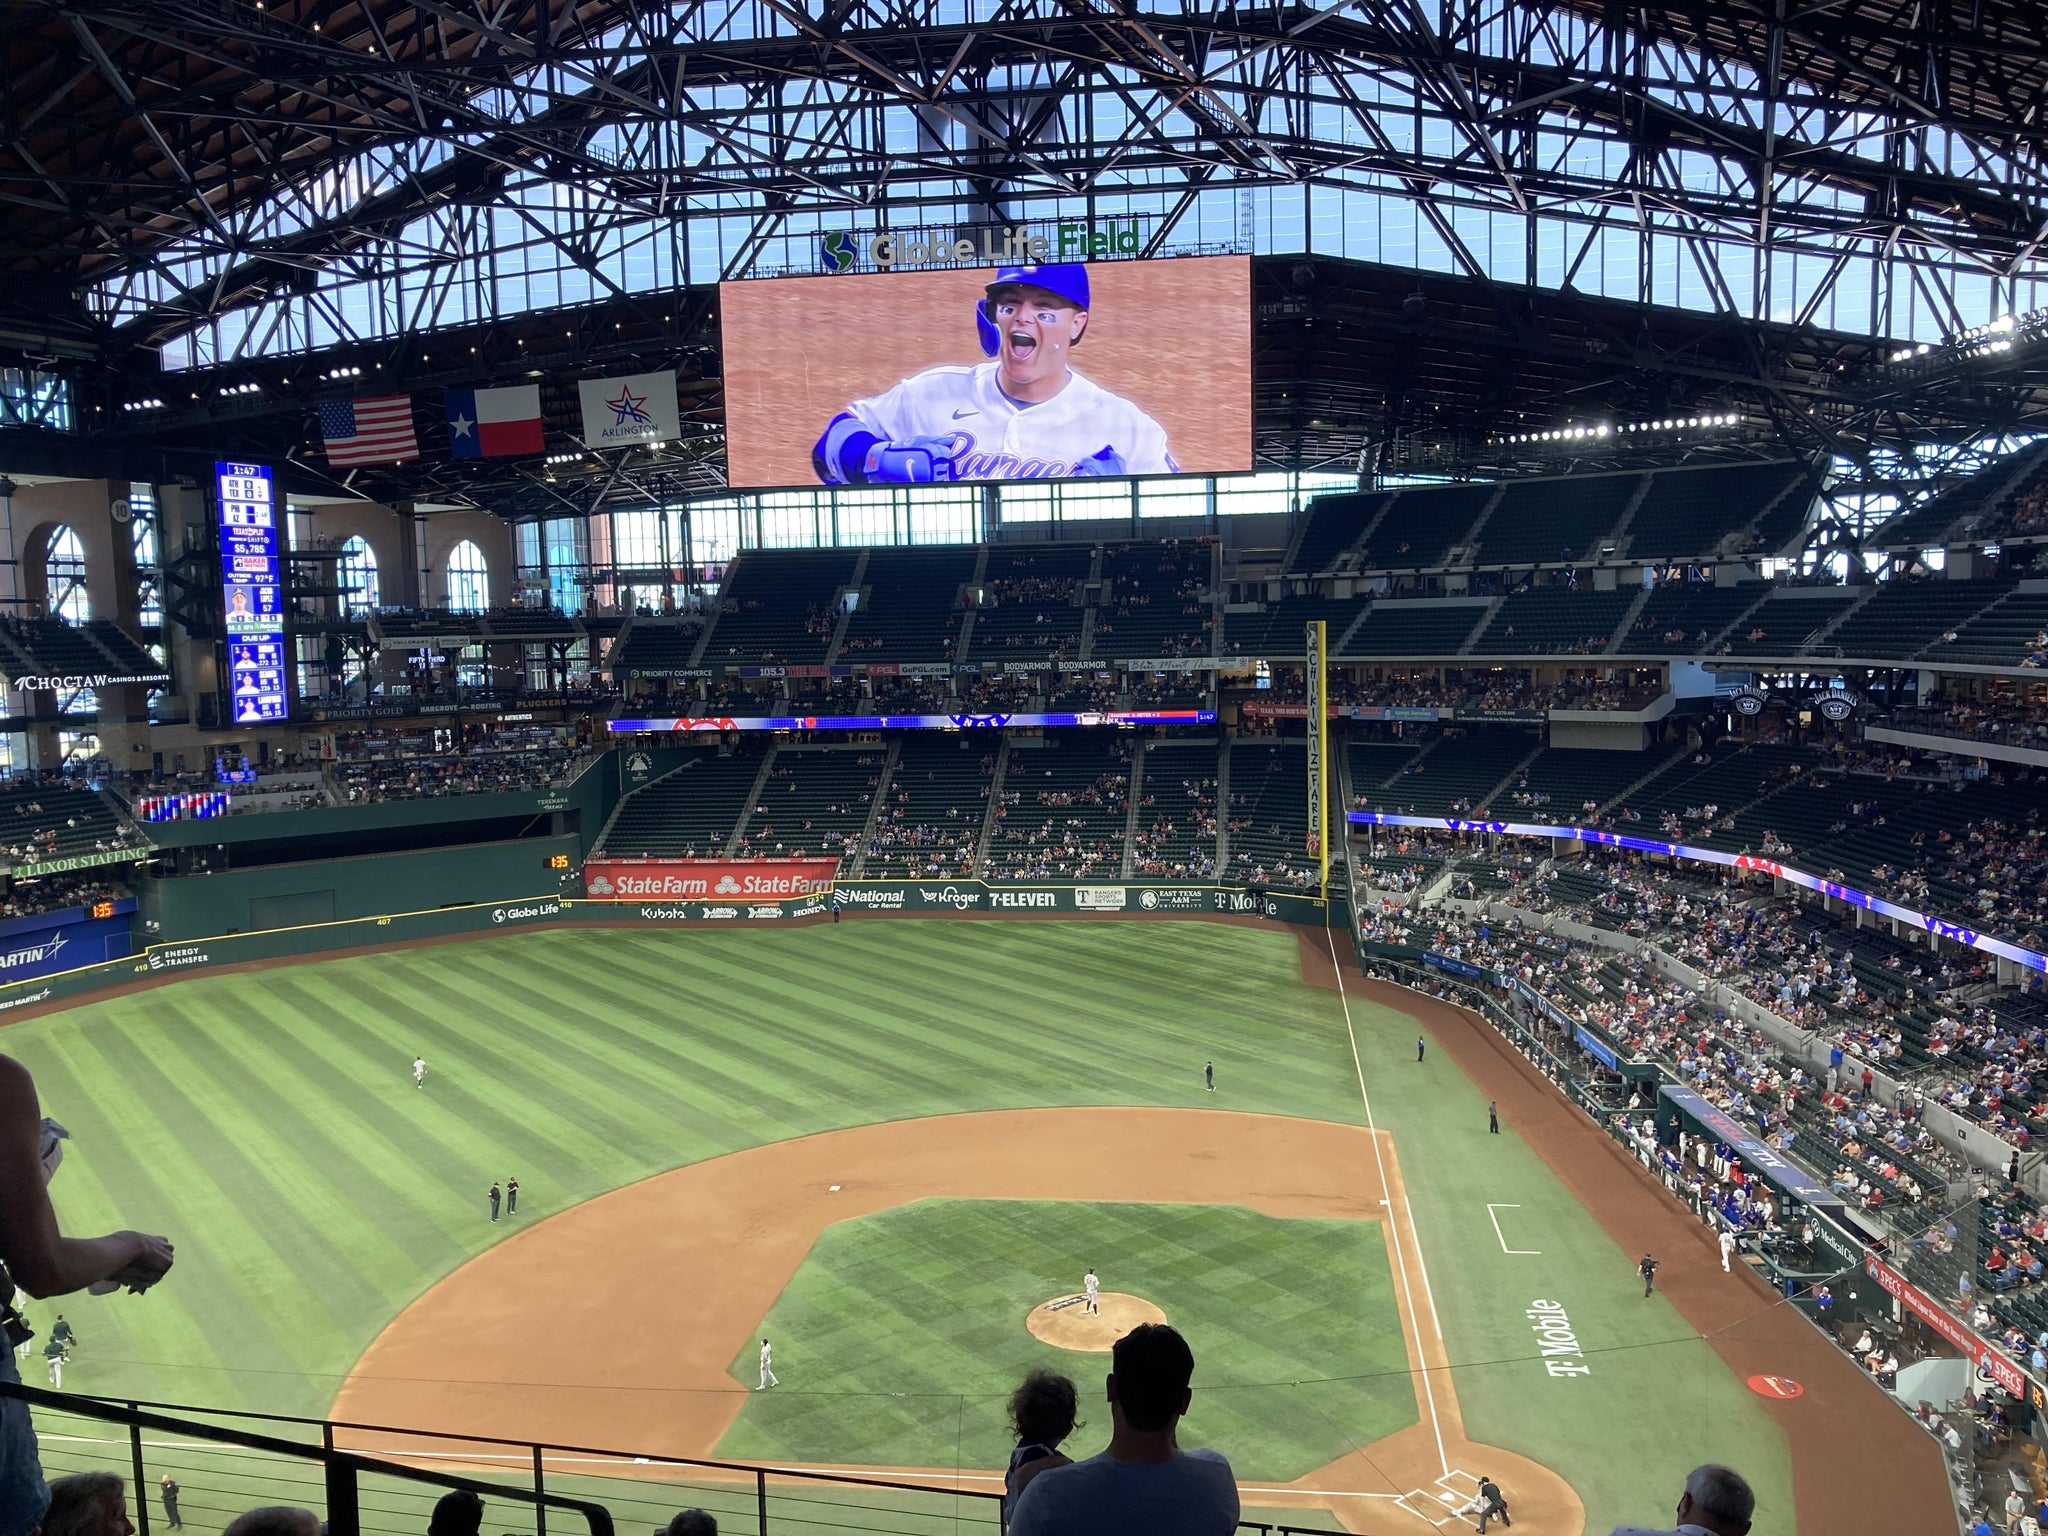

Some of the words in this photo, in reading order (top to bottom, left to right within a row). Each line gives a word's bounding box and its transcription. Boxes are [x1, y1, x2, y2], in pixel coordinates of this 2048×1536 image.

[870, 230, 976, 267] Globe
[984, 224, 1048, 261] Life
[1057, 219, 1139, 256] Field
[601, 424, 659, 438] ARLINGTON
[233, 466, 255, 476] 1:47
[115, 504, 128, 518] 10
[263, 604, 273, 612] 57
[760, 667, 785, 676] 105.3
[902, 664, 947, 673] GoPGL.com
[960, 665, 980, 673] PGL
[1004, 662, 1052, 671] BODYARMOR
[1058, 661, 1107, 670] BODYARMOR
[674, 669, 713, 677] COMMERCE
[24, 674, 107, 691] CHOCTAW
[108, 676, 136, 684] CASINOS
[142, 675, 170, 683] RESORTS
[1728, 687, 1743, 700] JACK
[1814, 690, 1831, 705] JACK
[420, 704, 458, 713] HARGROVE
[470, 702, 502, 710] ROOFING
[516, 699, 568, 708] PLUCKERS
[327, 708, 373, 718] PRIORITY
[375, 707, 404, 716] GOLD
[1311, 773, 1319, 828] FARE
[26, 857, 78, 876] LUXOR
[80, 846, 146, 868] STAFFING
[551, 855, 569, 868] 1:35
[849, 889, 905, 903] National
[939, 886, 980, 910] Kroger
[1170, 896, 1190, 904] A&M
[93, 902, 113, 918] 1:35
[507, 907, 538, 919] Globe
[539, 904, 559, 915] Life
[641, 908, 686, 919] Kubota
[793, 904, 827, 918] HONDA
[377, 918, 391, 926] 407
[165, 948, 199, 958] ENERGY
[166, 955, 209, 967] TRANSFER
[134, 964, 148, 972] 410
[15, 994, 41, 1006] MARTIN
[1820, 1228, 1844, 1256] Medical
[1843, 1247, 1858, 1267] City
[1880, 1269, 1901, 1296] SPEC'S
[1525, 1298, 1584, 1358] Mobile
[1994, 1361, 2022, 1394] SPEC'S
